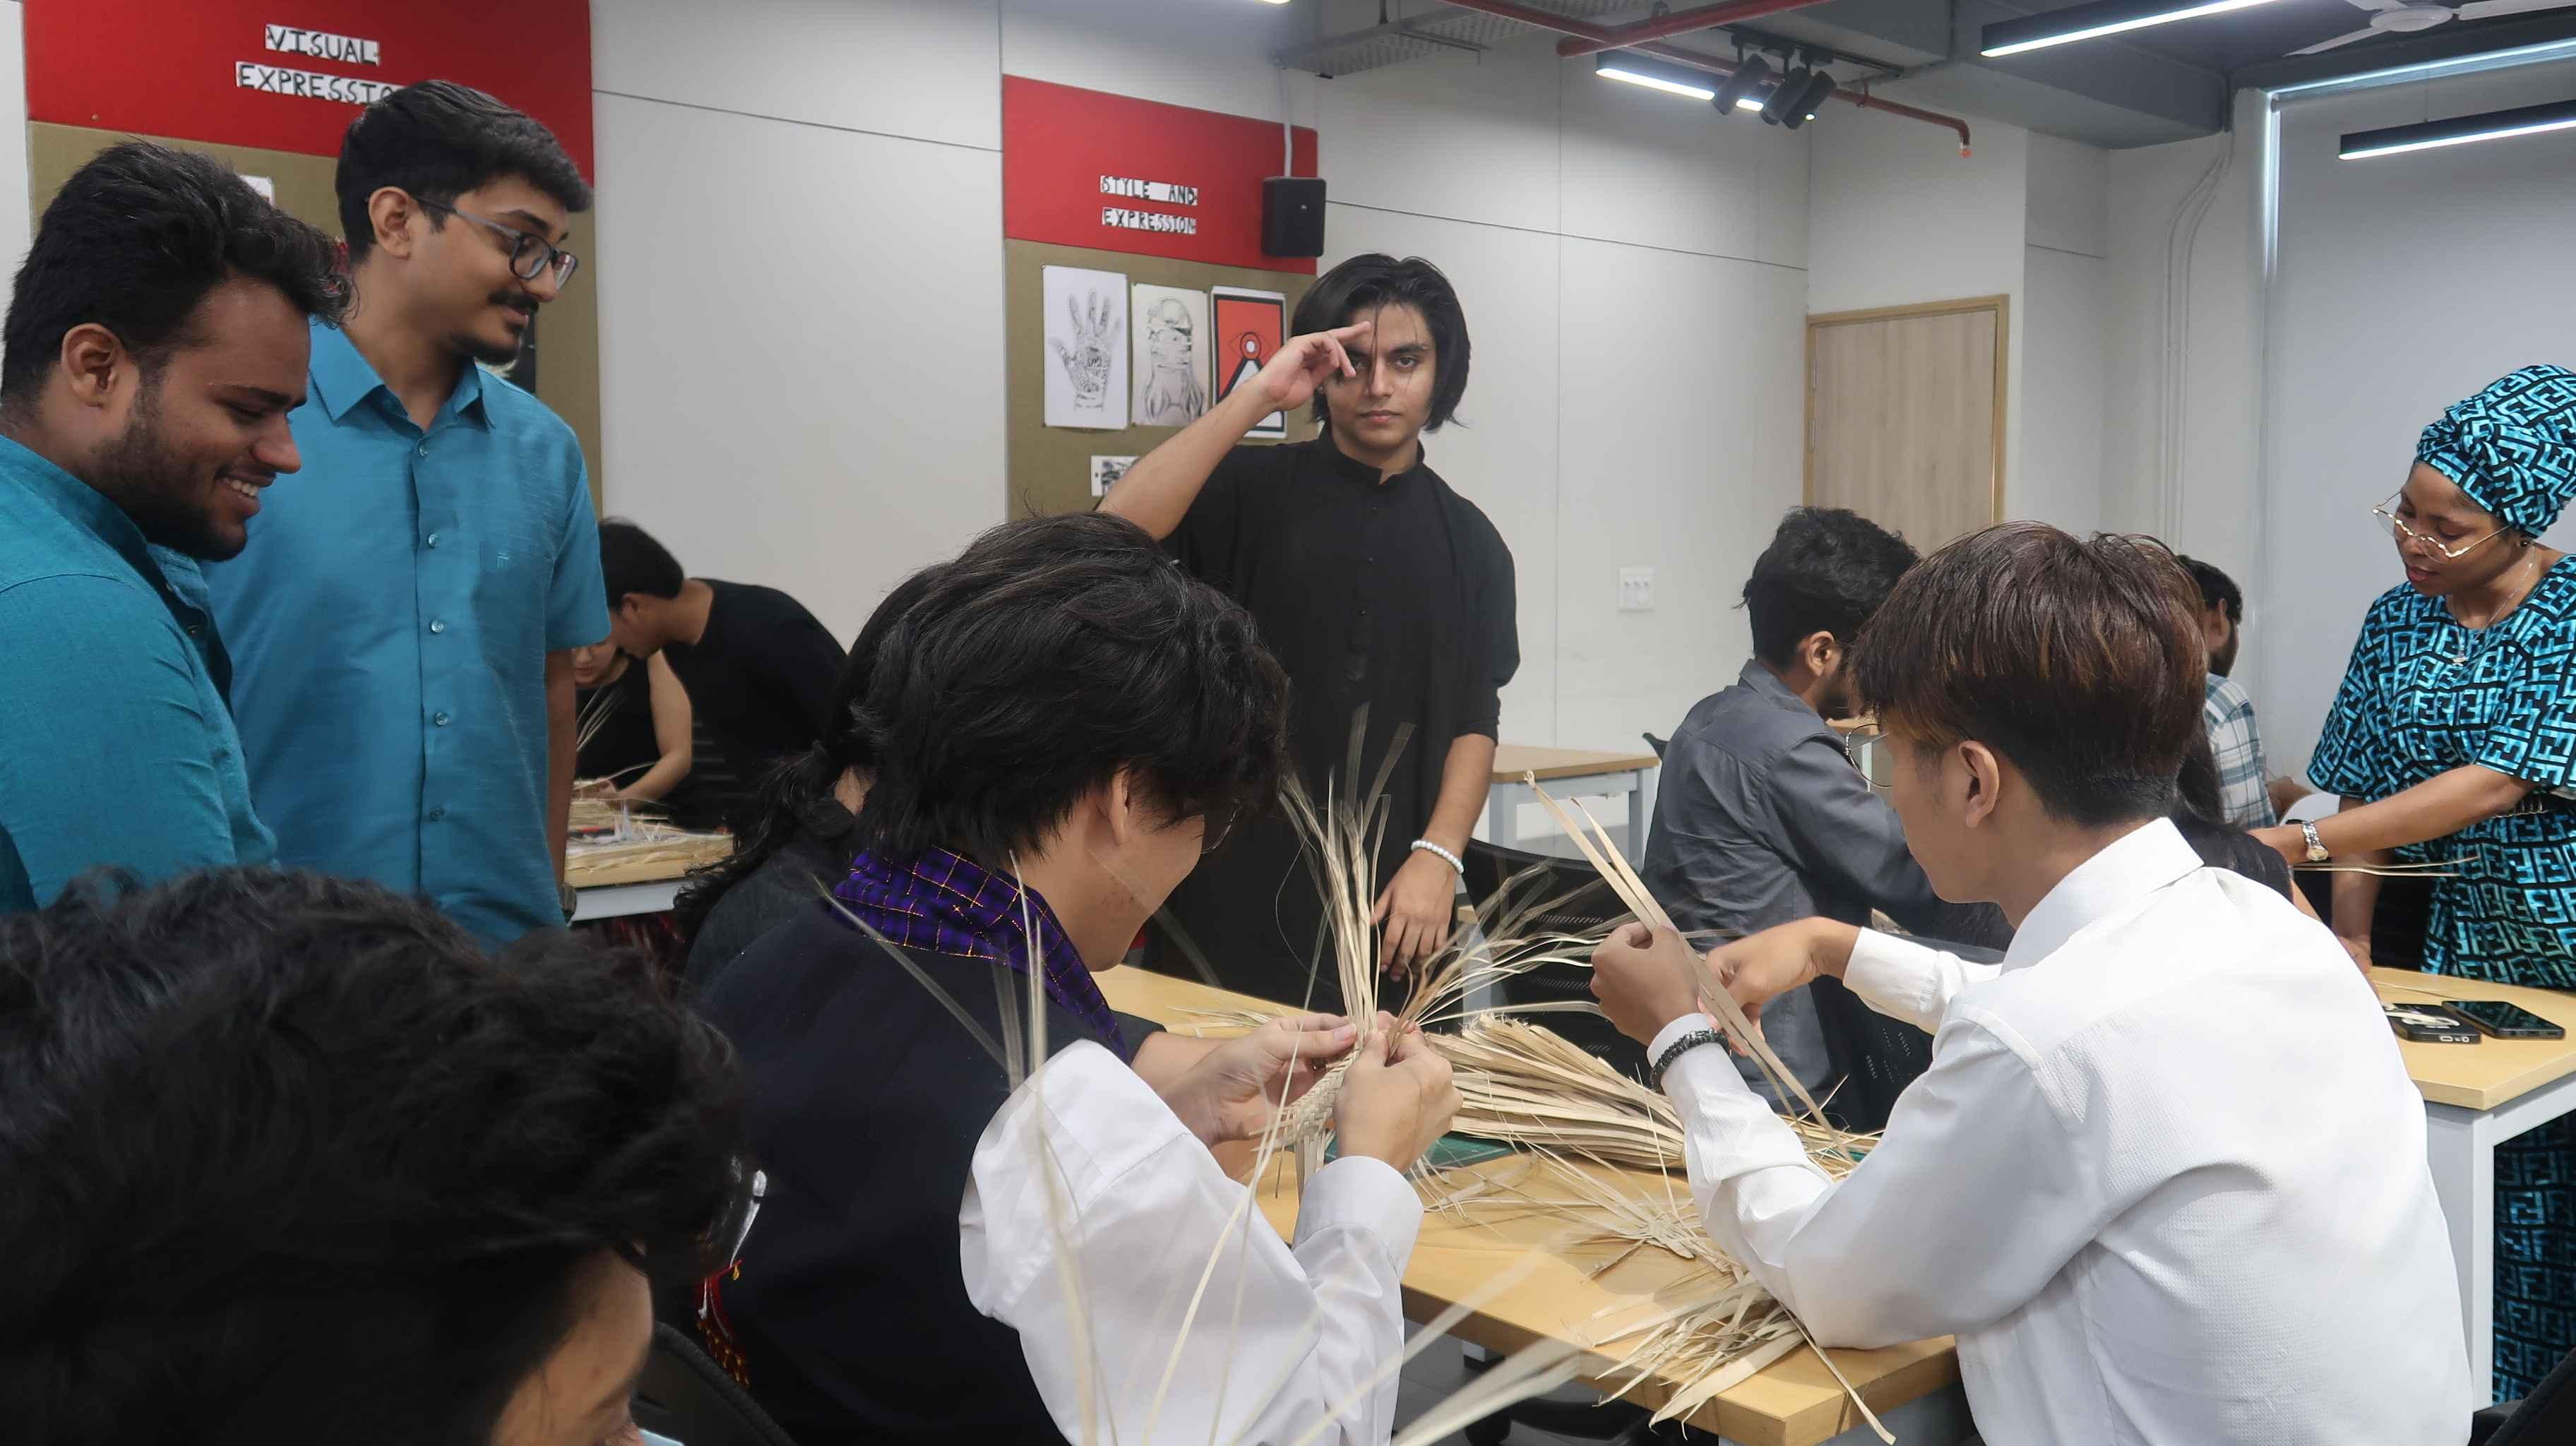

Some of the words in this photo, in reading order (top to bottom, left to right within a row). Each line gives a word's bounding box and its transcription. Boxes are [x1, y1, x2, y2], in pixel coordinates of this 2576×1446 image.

[267, 26, 377, 65] VISUAL
[239, 64, 394, 105] EXPRESSIO
[1102, 177, 1150, 199] STYLE
[1168, 184, 1195, 205] AND
[1104, 209, 1195, 234] EXPRESSION
